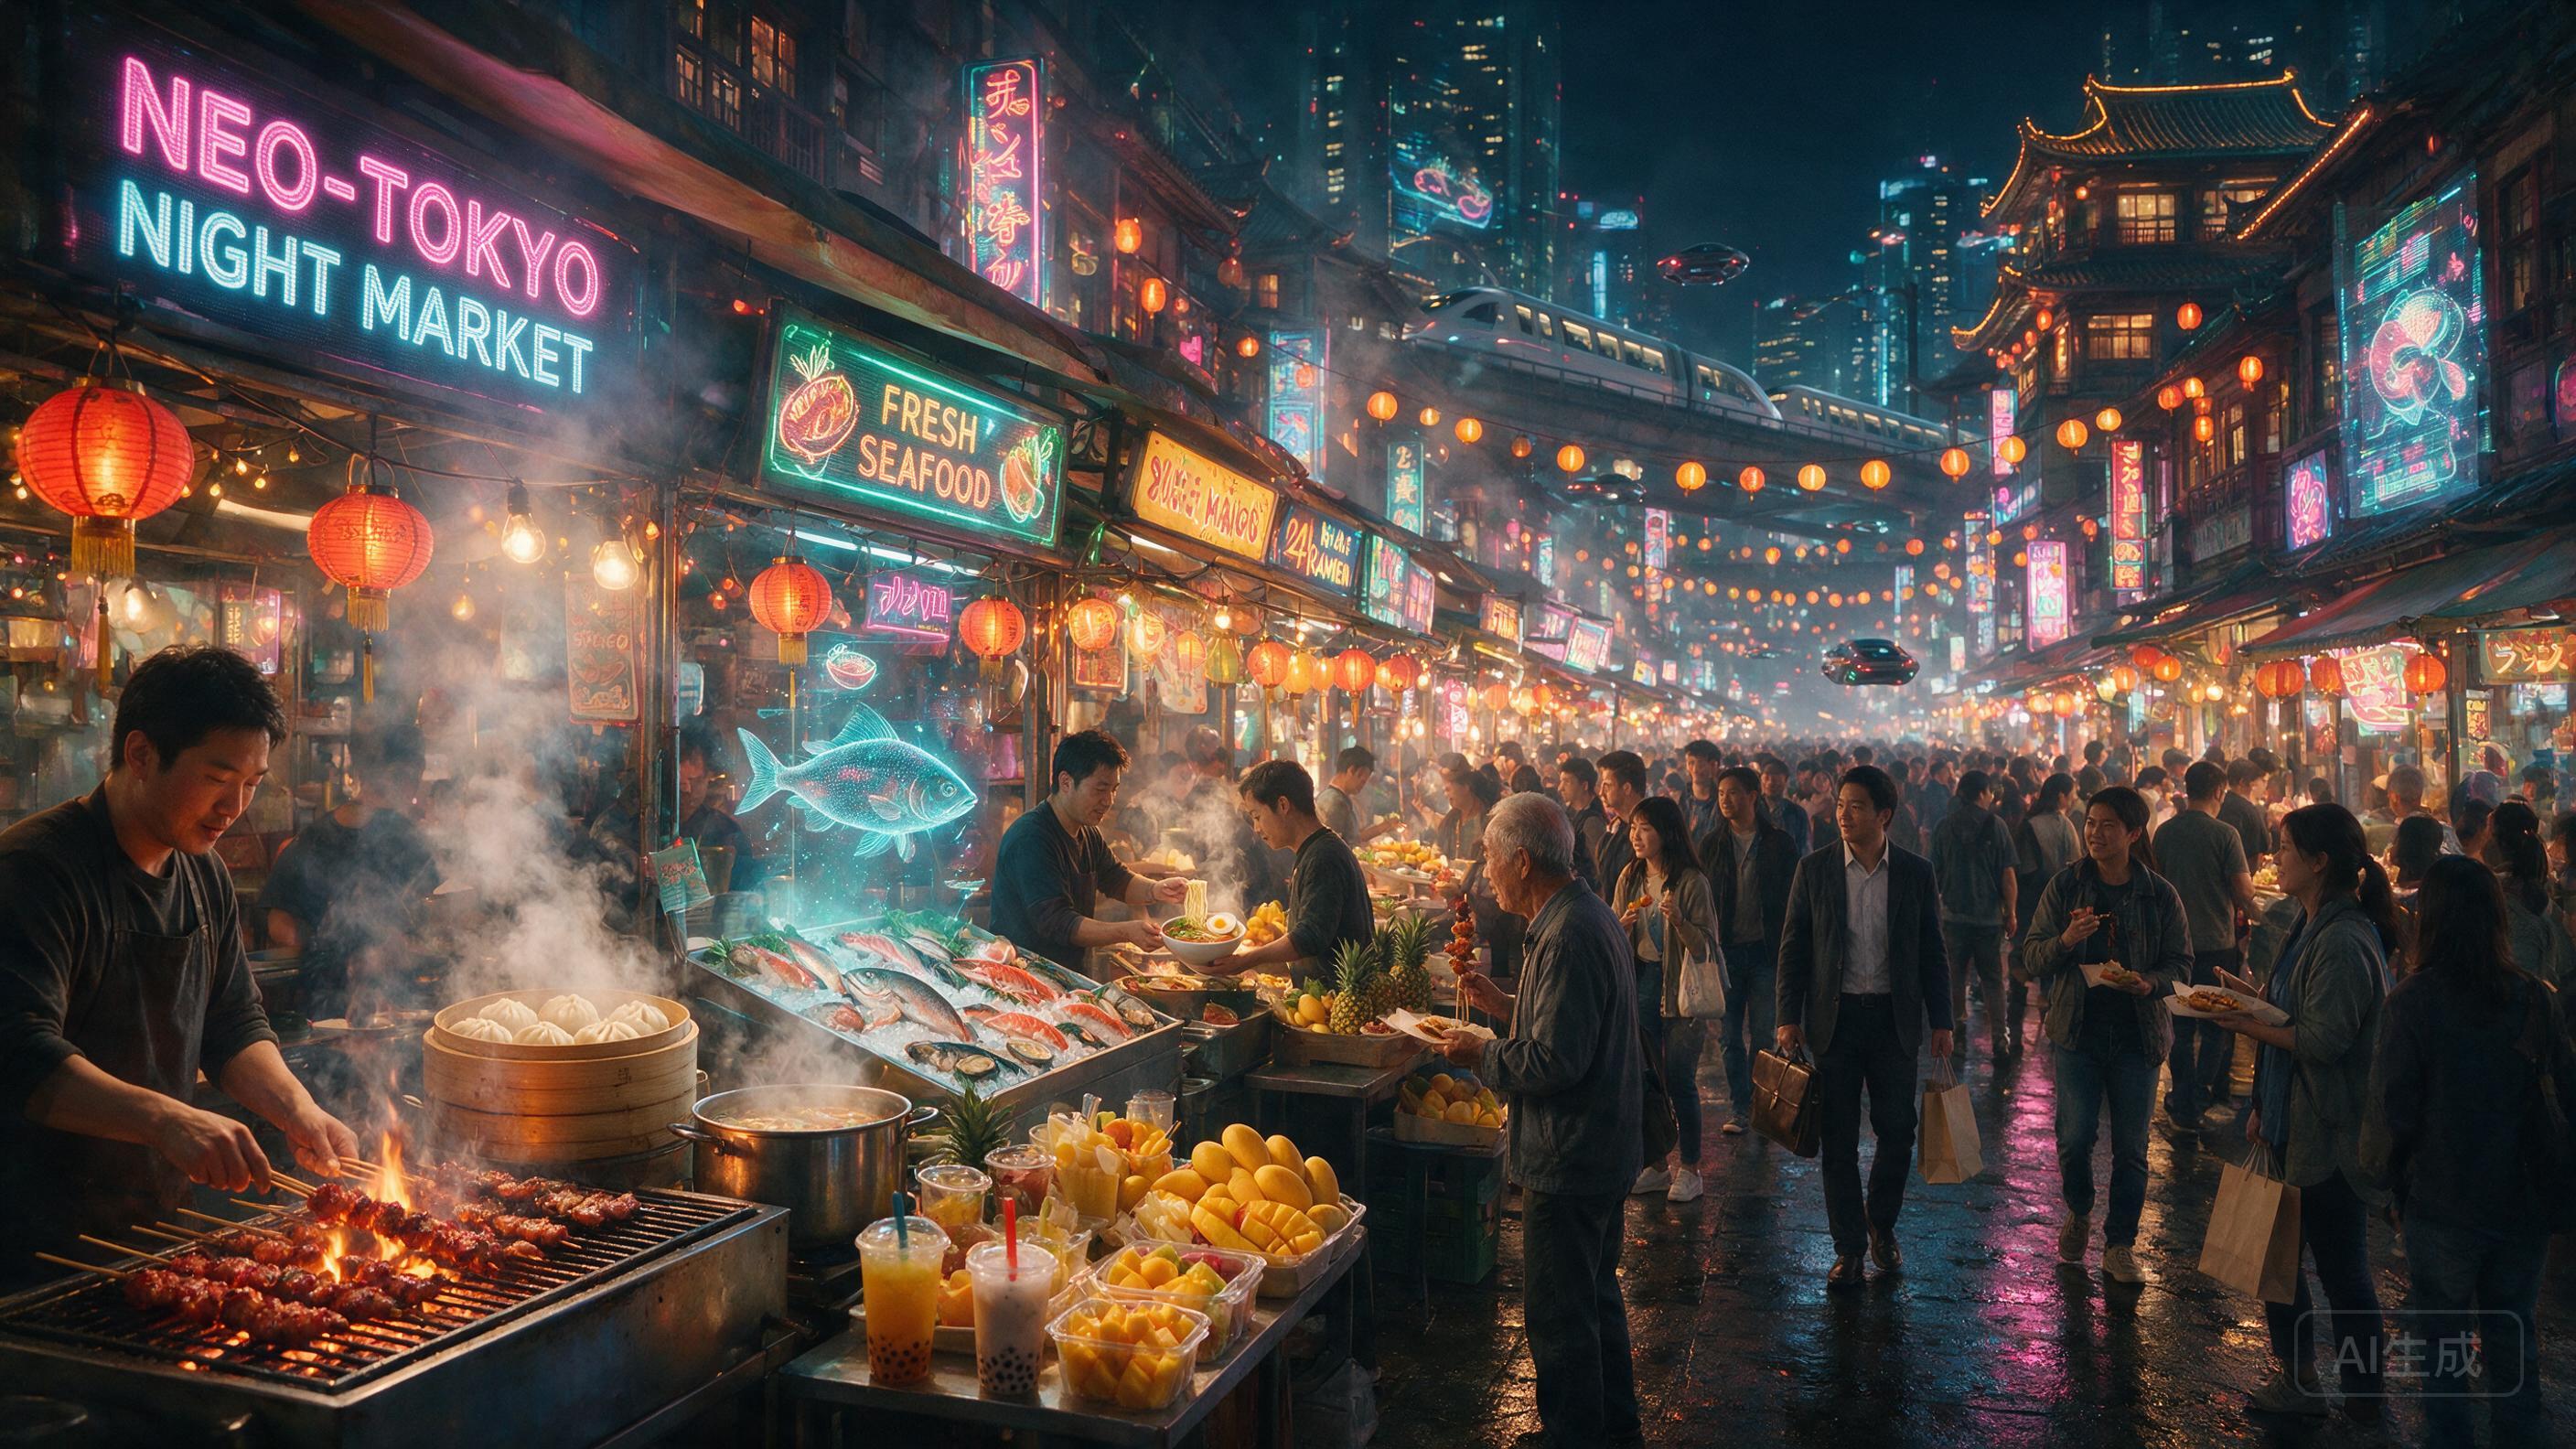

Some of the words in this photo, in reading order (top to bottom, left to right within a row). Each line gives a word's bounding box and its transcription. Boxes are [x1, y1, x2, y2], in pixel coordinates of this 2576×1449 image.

[122, 56, 600, 317] NEO-TOKYO
[120, 179, 341, 316] NIGHT
[363, 263, 594, 394] MARKET
[858, 434, 992, 510] SEAFOOD
[881, 383, 978, 455] FRESH
